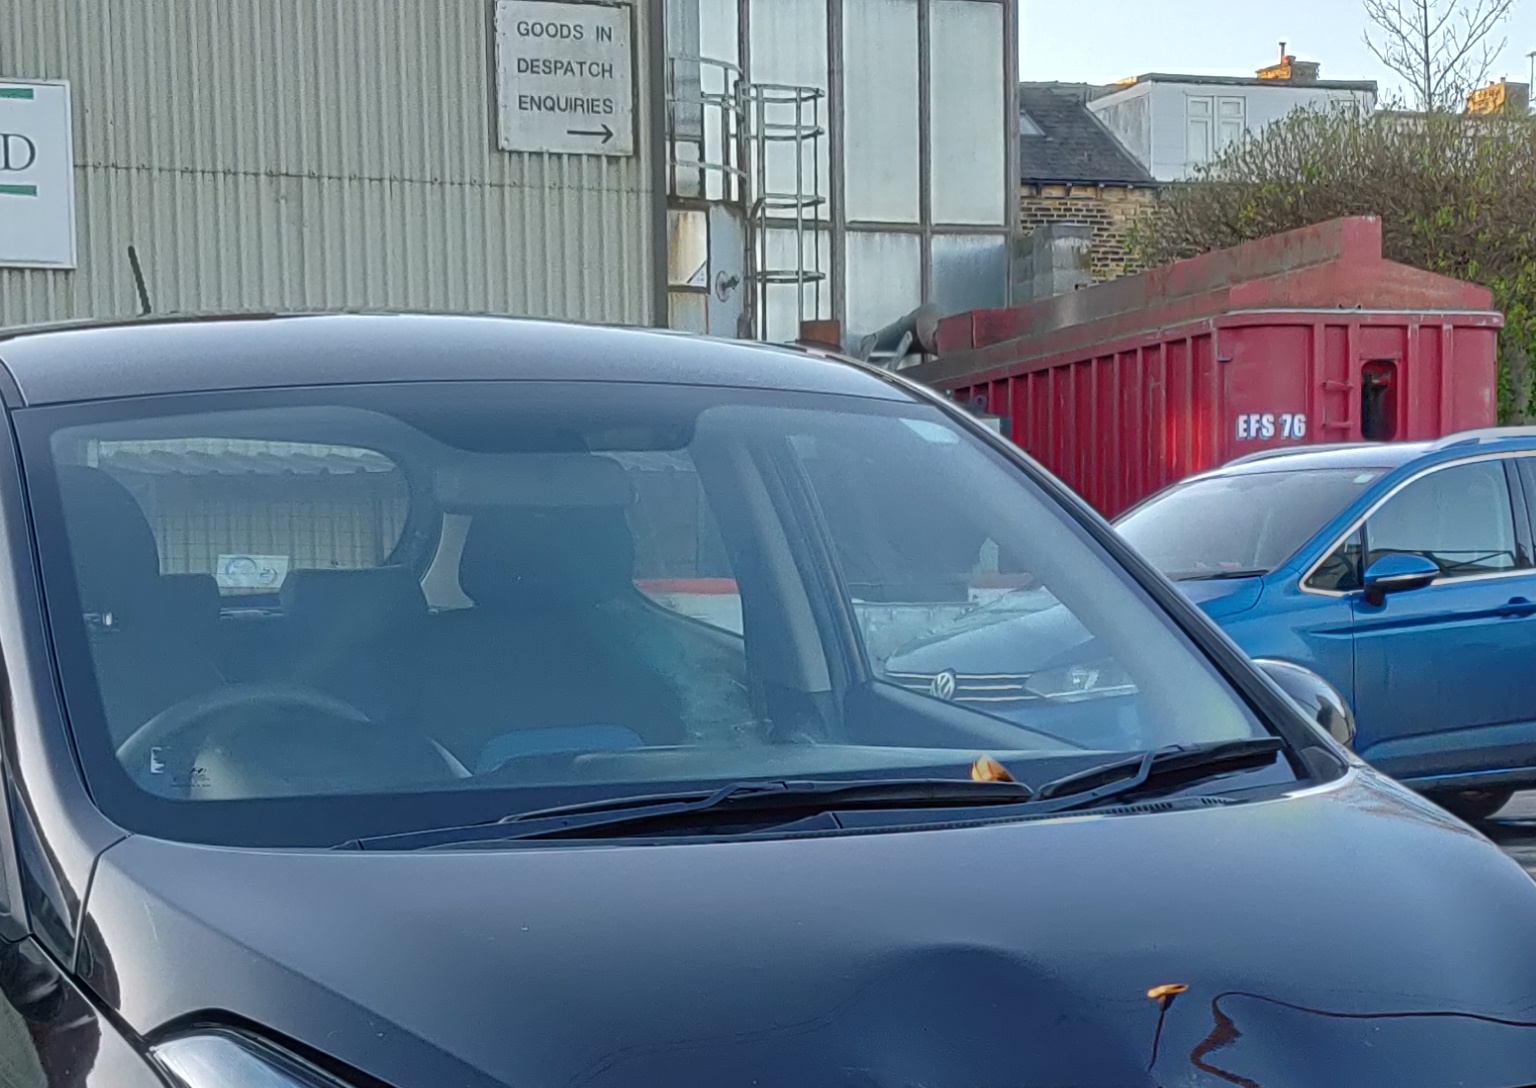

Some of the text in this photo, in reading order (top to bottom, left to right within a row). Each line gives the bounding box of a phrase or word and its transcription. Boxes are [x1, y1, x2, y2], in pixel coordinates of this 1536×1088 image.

[517, 21, 613, 43] GOODS IN
[517, 58, 614, 79] DESPATCH
[518, 95, 614, 115] ENQUIRIES
[1236, 413, 1307, 440] EFS 76
